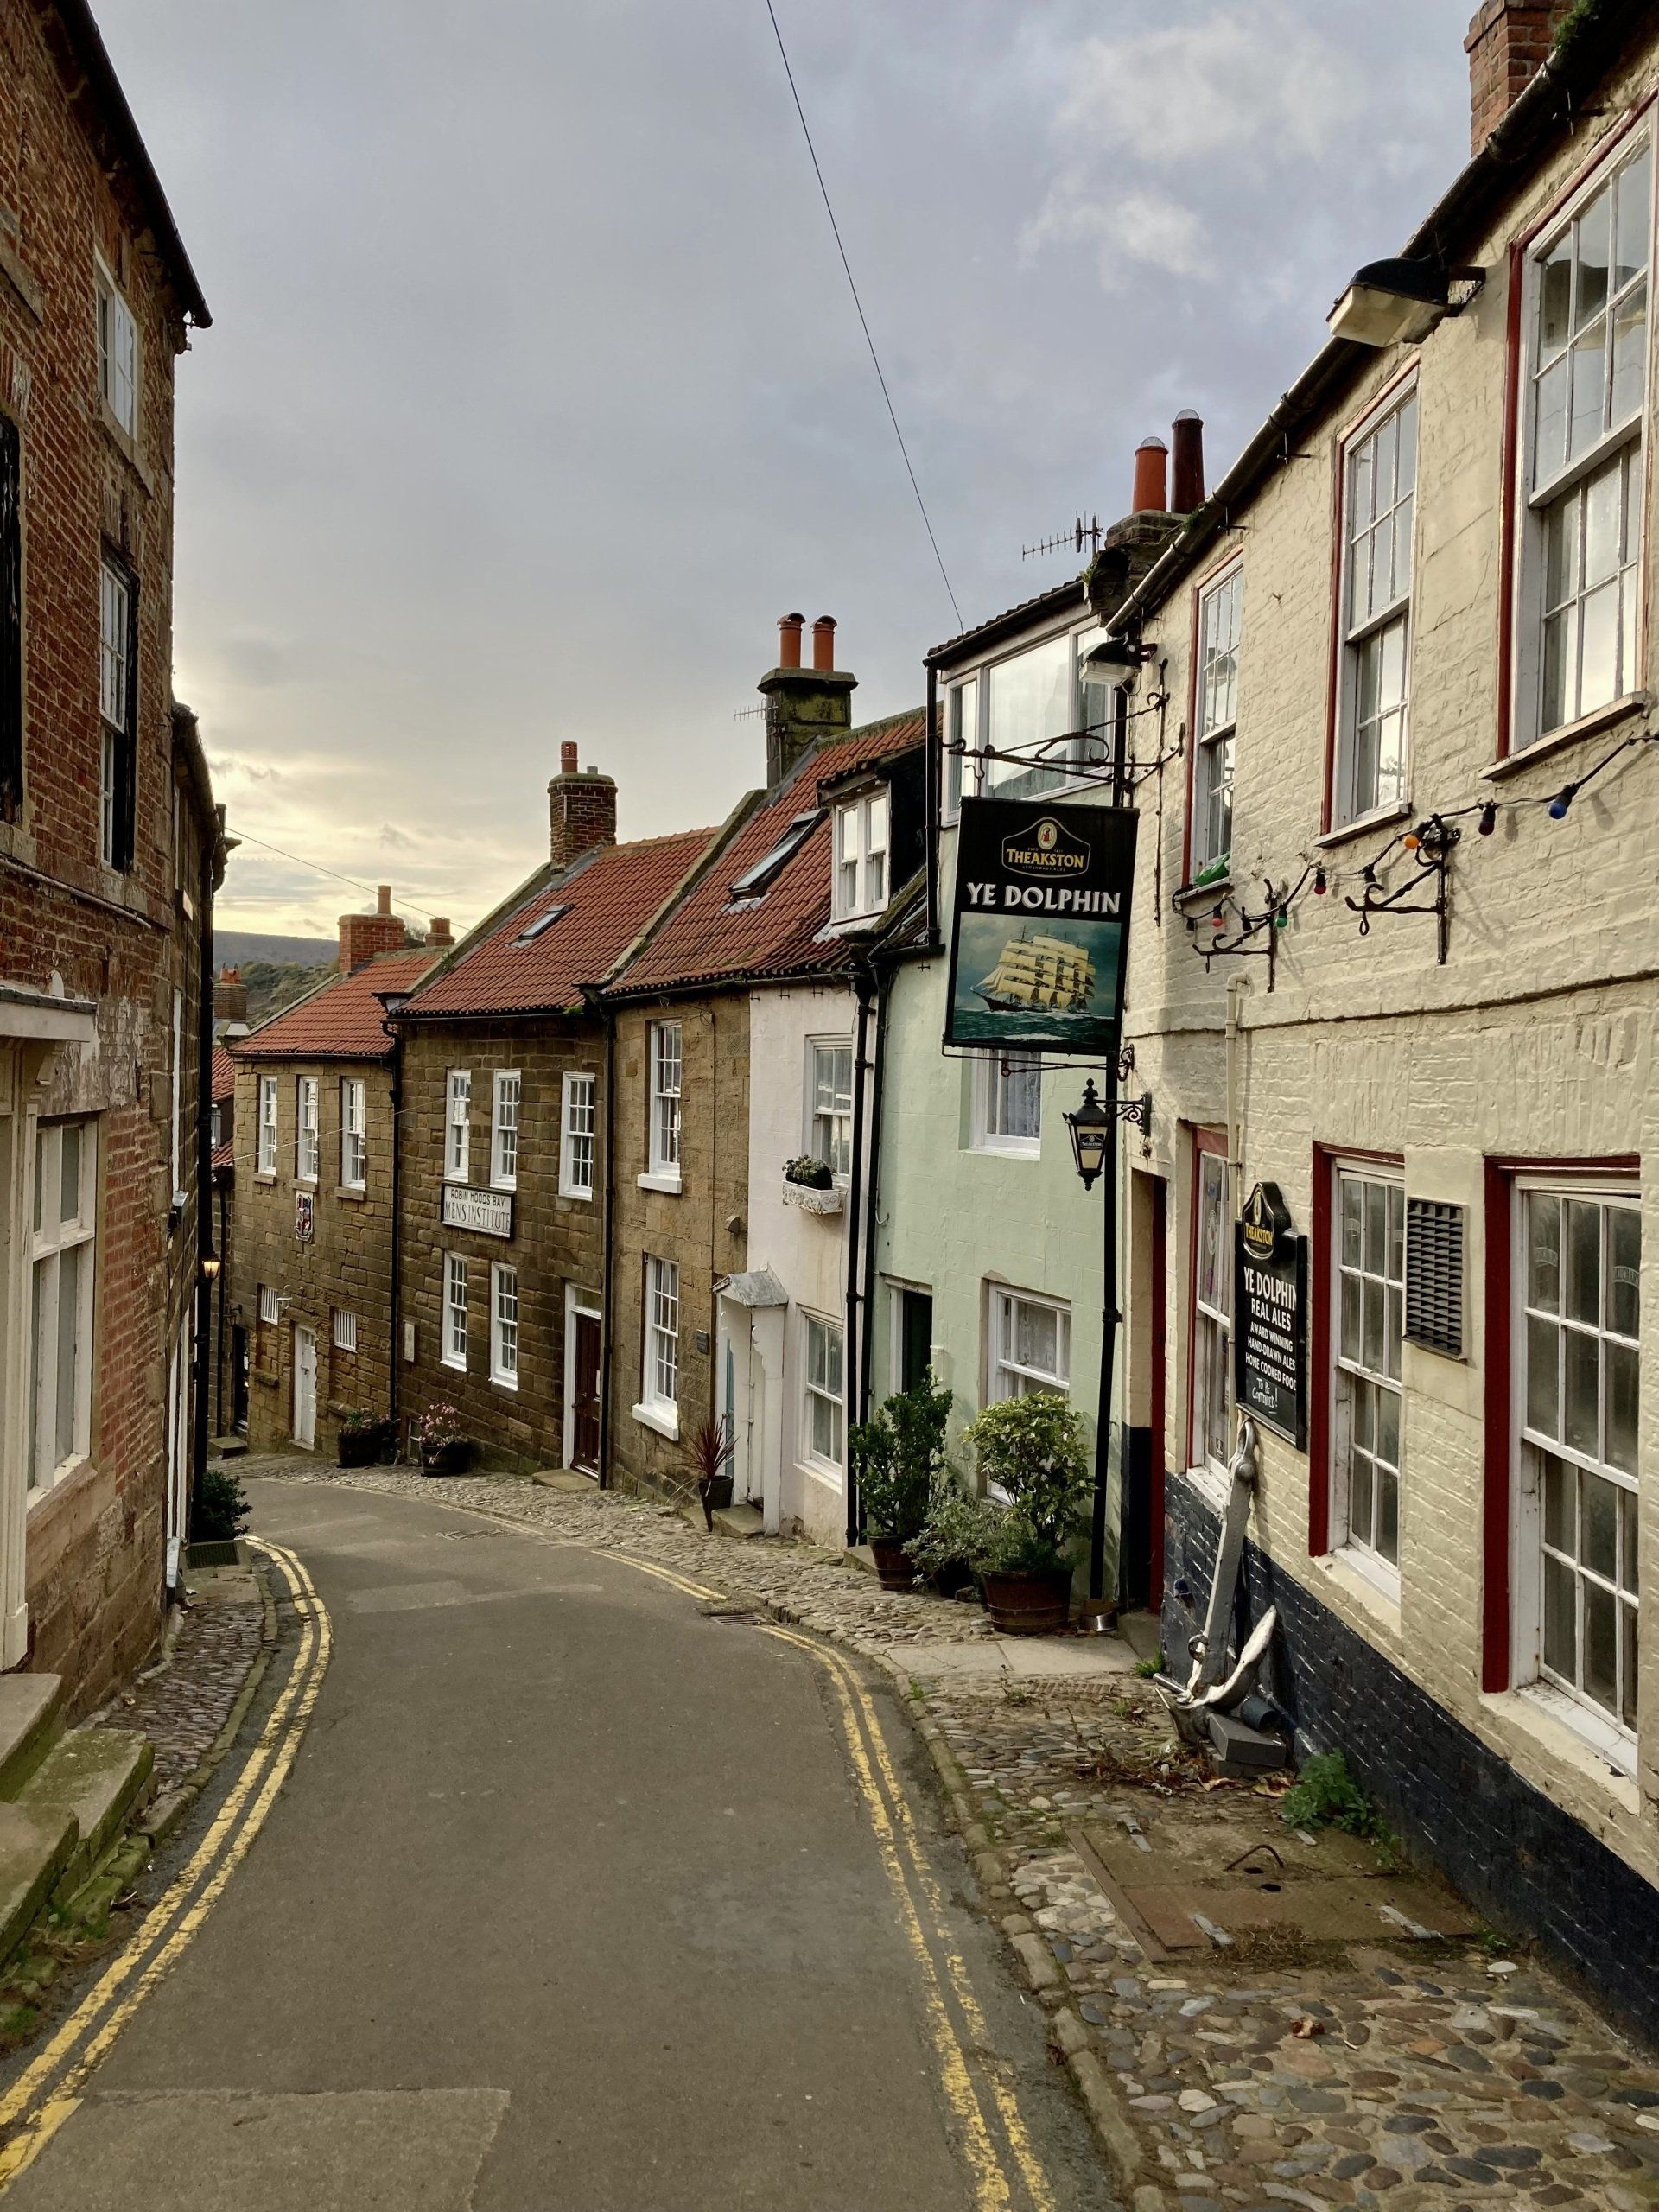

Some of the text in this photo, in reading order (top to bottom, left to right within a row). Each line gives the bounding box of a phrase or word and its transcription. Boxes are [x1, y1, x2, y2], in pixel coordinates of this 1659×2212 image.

[1006, 848, 1084, 868] THEAKSTON
[967, 881, 1121, 914] YE DOLPHIN
[450, 1188, 505, 1207] ROBIN HOODS BAY
[444, 1201, 510, 1230] MENS INSTITUTE
[1245, 1222, 1273, 1246] THEAKSTON
[1243, 1266, 1296, 1311] YE DOLPHIN
[1251, 1297, 1292, 1332] REAL ALES
[1250, 1320, 1294, 1353] AWARD WINNING
[1245, 1351, 1260, 1370] HOME
[1260, 1360, 1281, 1382] COOKED
[1247, 1335, 1296, 1372] HAND-DRAWN ALES
